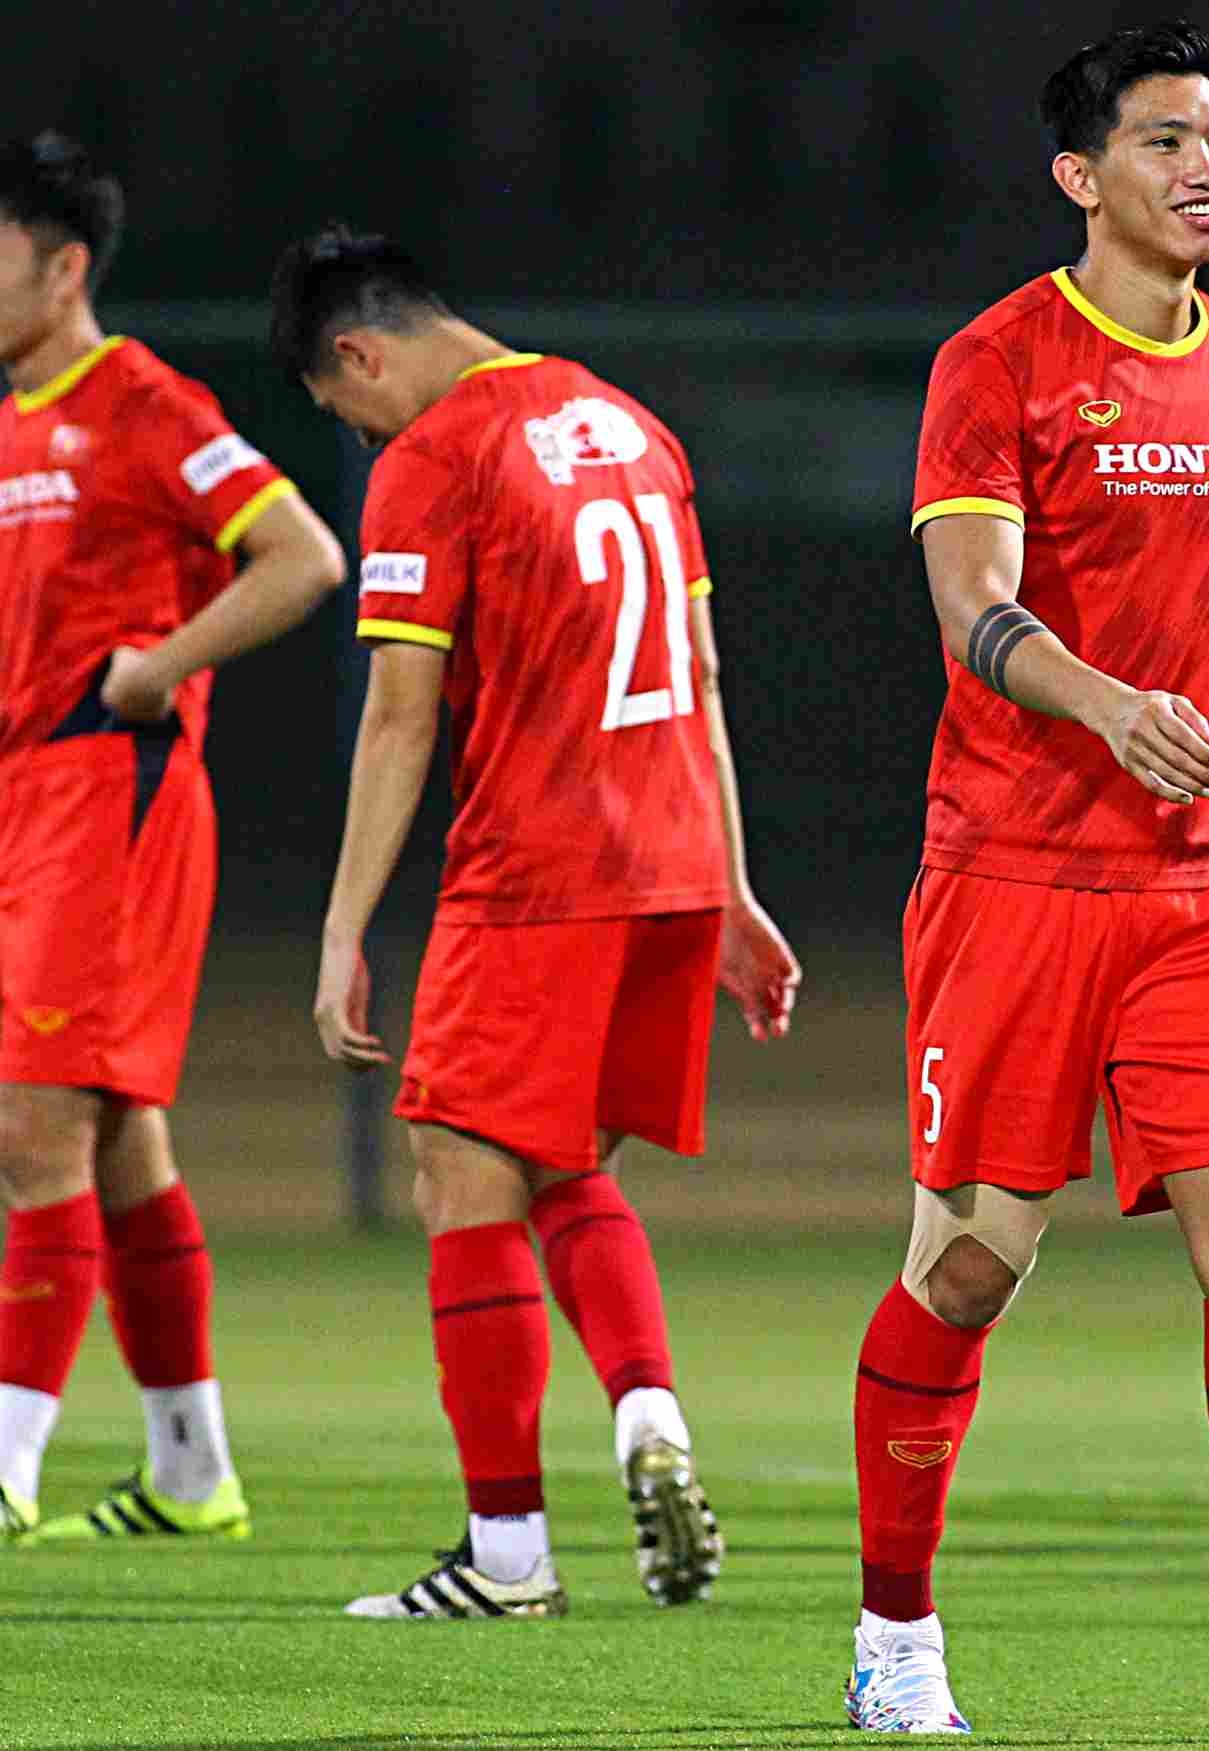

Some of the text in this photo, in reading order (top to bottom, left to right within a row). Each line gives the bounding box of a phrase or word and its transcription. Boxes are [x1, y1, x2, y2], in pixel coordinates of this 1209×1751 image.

[1102, 480, 1136, 496] The
[1139, 480, 1190, 496] Power
[575, 493, 694, 732] 21
[921, 1047, 944, 1144] 5
